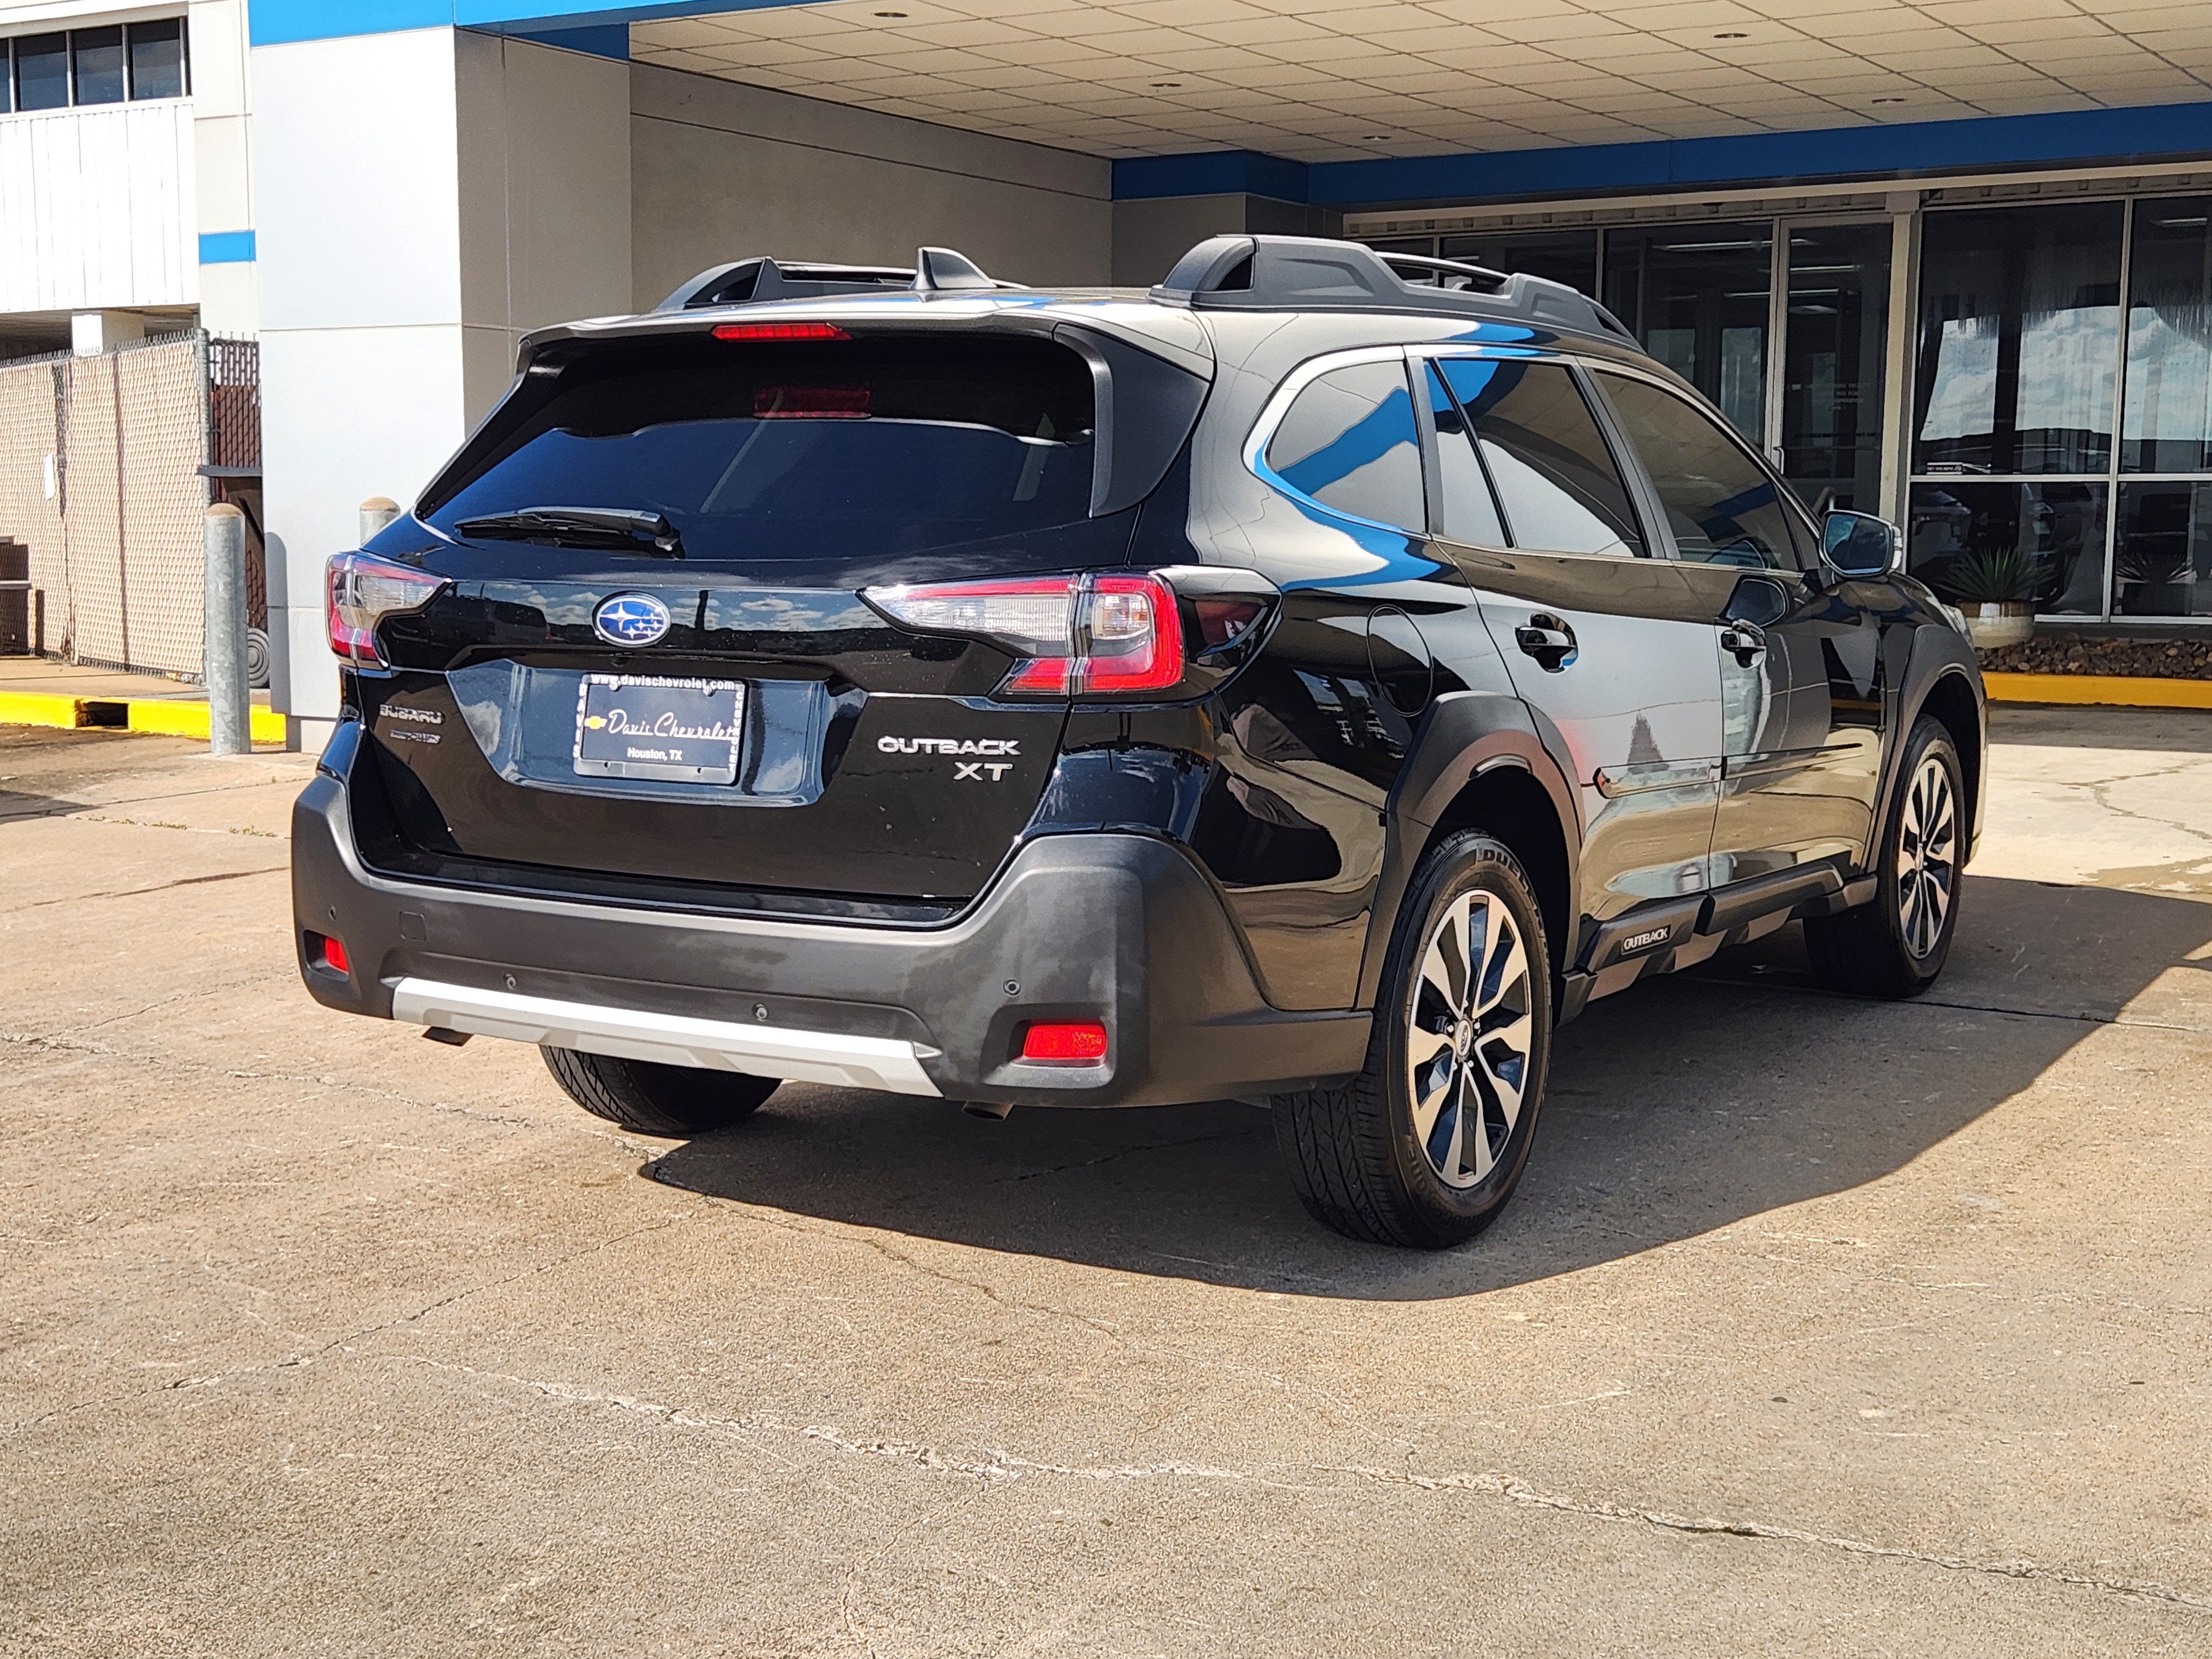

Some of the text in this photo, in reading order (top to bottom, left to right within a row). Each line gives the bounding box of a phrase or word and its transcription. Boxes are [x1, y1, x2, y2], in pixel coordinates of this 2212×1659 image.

[591, 674, 735, 692] www.davischevrolet.com
[379, 704, 442, 724] SUBARU
[573, 684, 587, 758] DAVIS
[608, 709, 740, 740] Davis Chevrolet
[728, 692, 743, 773] CHEVROLET
[627, 747, 684, 761] Houston, TX
[878, 736, 1021, 755] OUTBACK
[953, 761, 1013, 781] XT
[1623, 927, 1668, 950] OUTBACK
